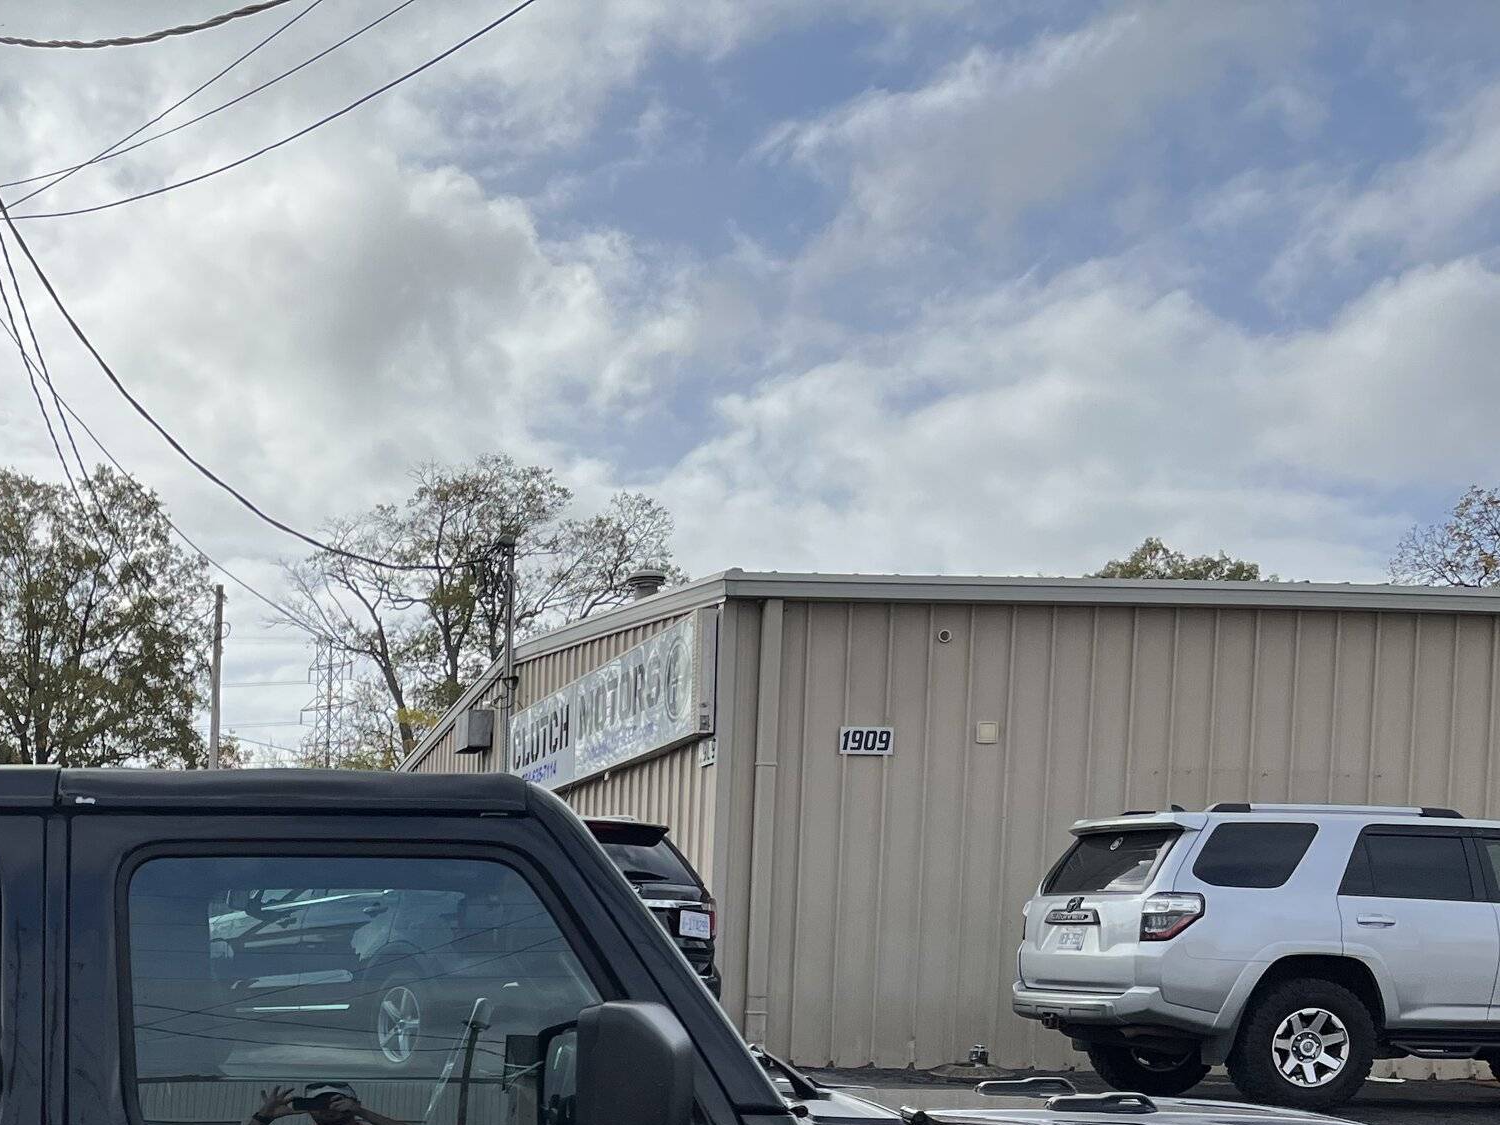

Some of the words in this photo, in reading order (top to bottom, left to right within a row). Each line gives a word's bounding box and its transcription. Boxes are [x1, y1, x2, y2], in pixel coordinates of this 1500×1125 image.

[513, 704, 570, 771] CLUTCH
[578, 655, 661, 741] MOTORS
[842, 730, 891, 750] 1909
